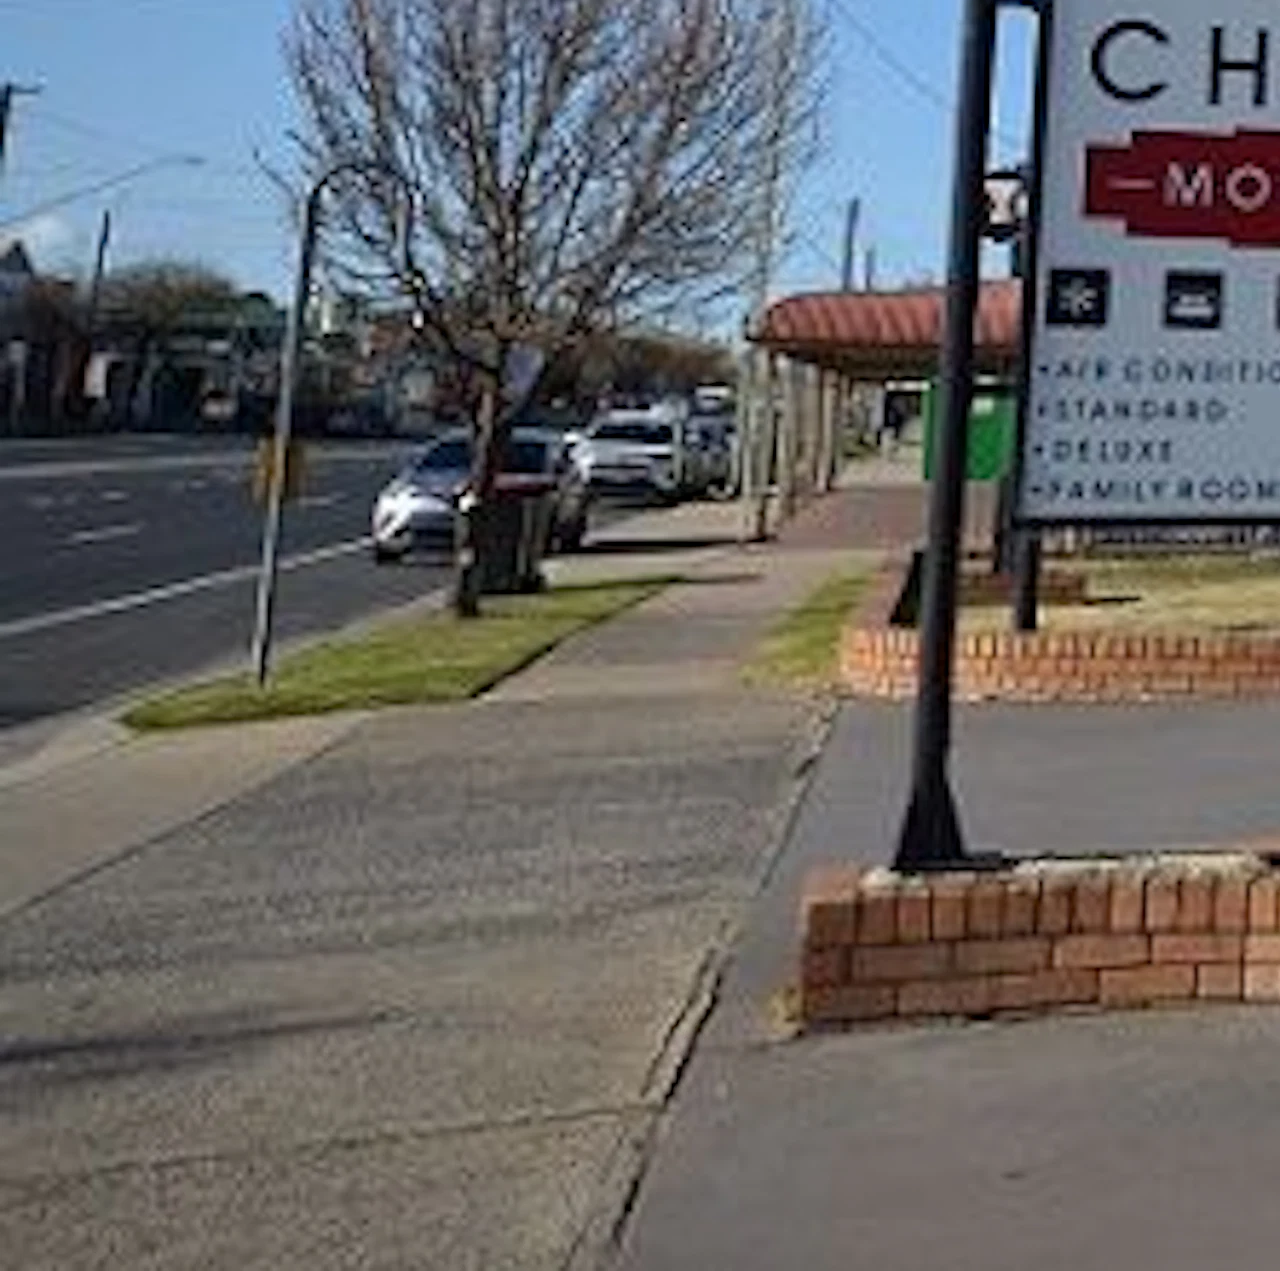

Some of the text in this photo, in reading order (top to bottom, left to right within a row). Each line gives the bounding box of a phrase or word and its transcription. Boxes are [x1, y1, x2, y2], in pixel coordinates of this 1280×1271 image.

[1054, 357, 1111, 383] AIR
[1055, 397, 1229, 423] STANDARD
[1053, 437, 1173, 464] DELUXE
[1050, 479, 1166, 504] FAMILY
